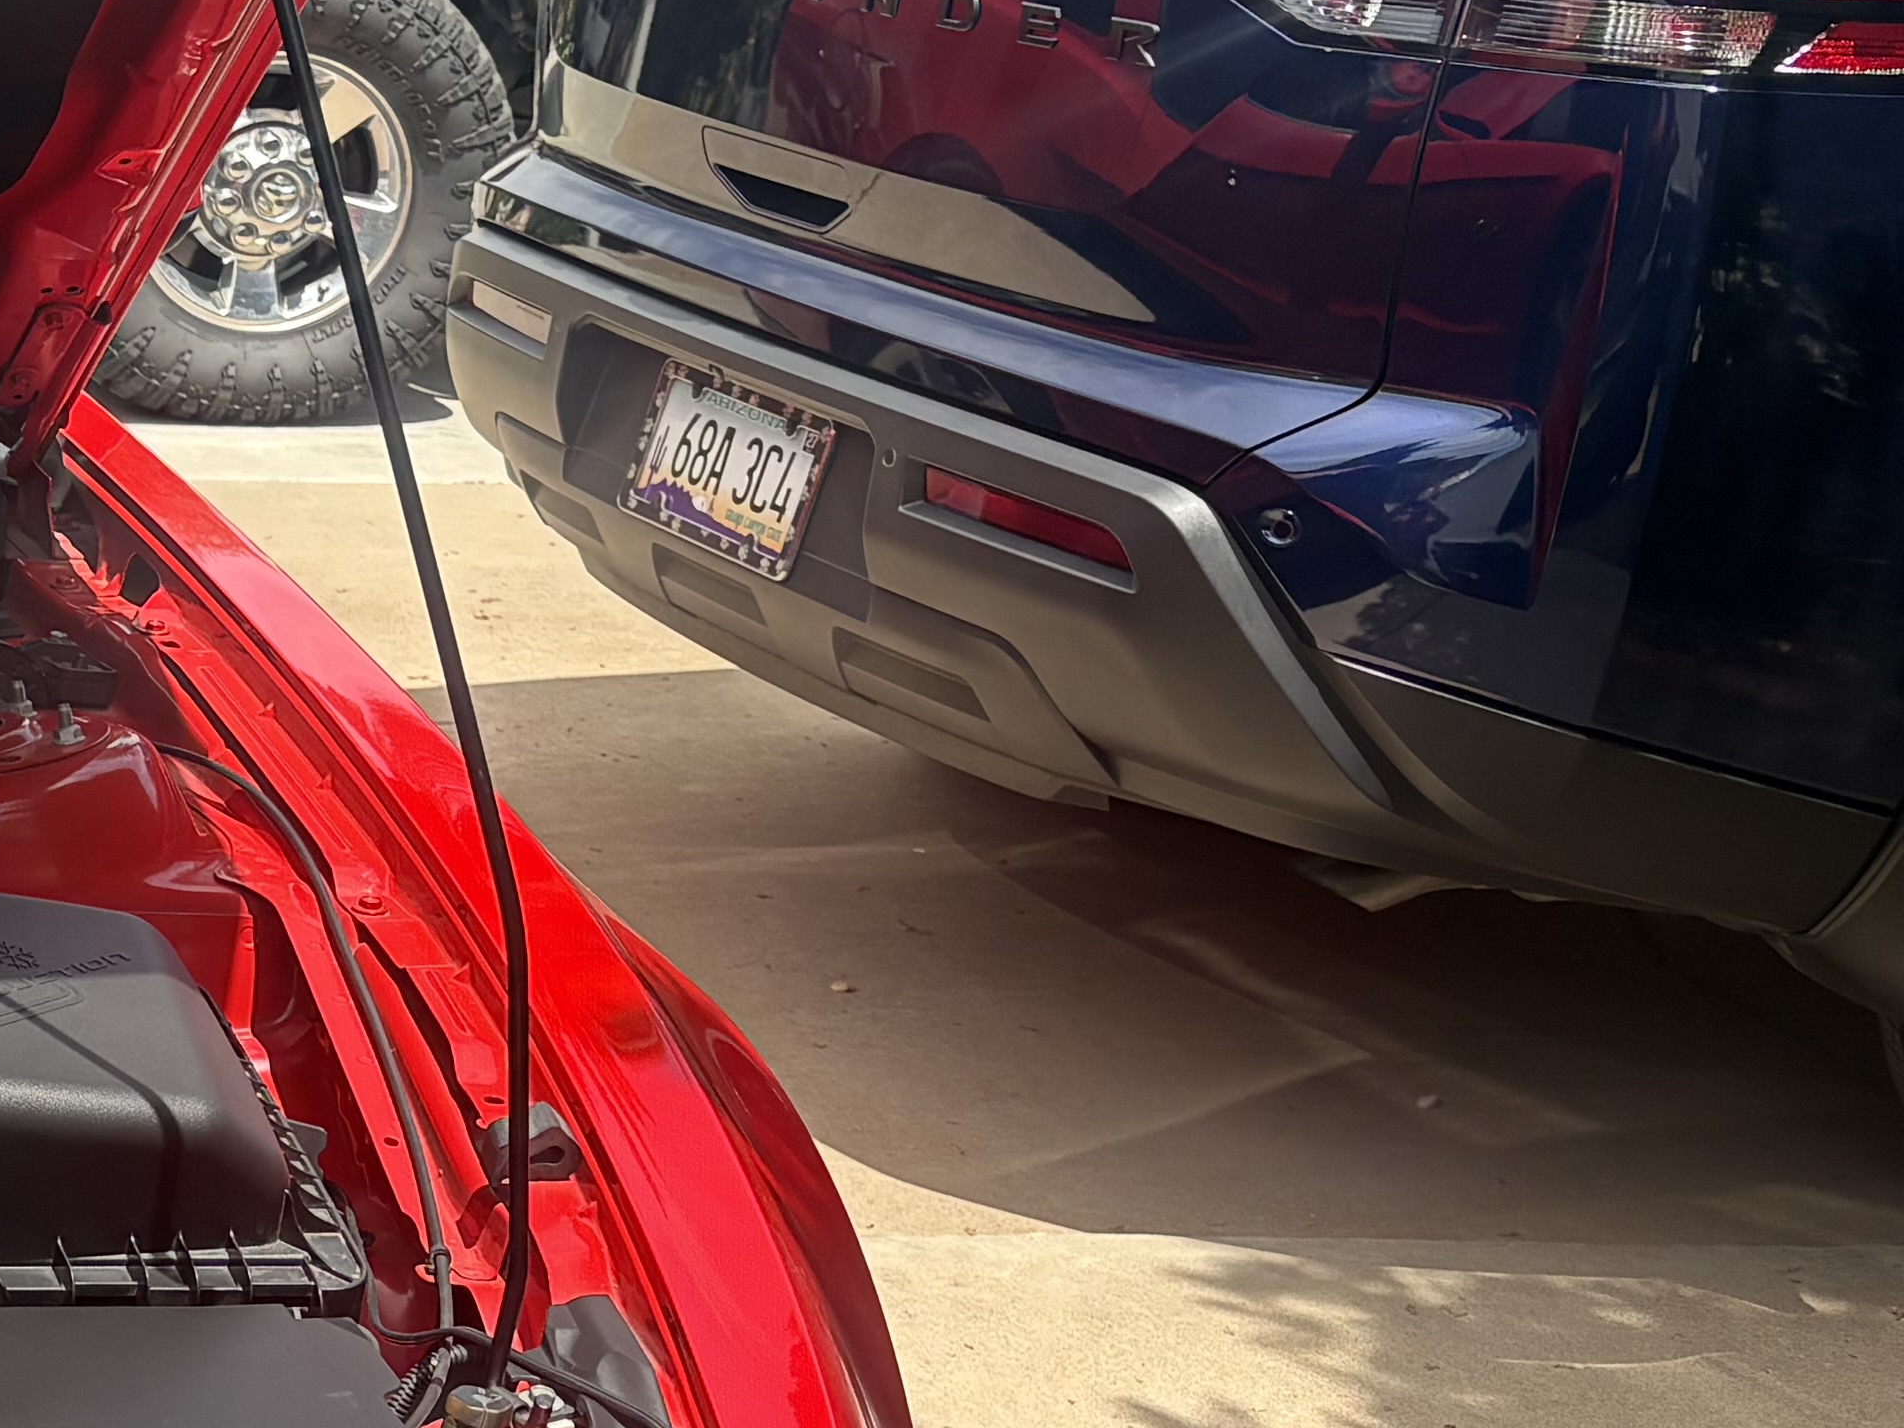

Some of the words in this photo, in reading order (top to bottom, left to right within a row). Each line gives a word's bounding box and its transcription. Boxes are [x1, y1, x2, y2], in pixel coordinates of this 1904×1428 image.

[706, 392, 788, 431] ARIZONA
[671, 413, 736, 496] 68A
[732, 437, 797, 523] 3C4
